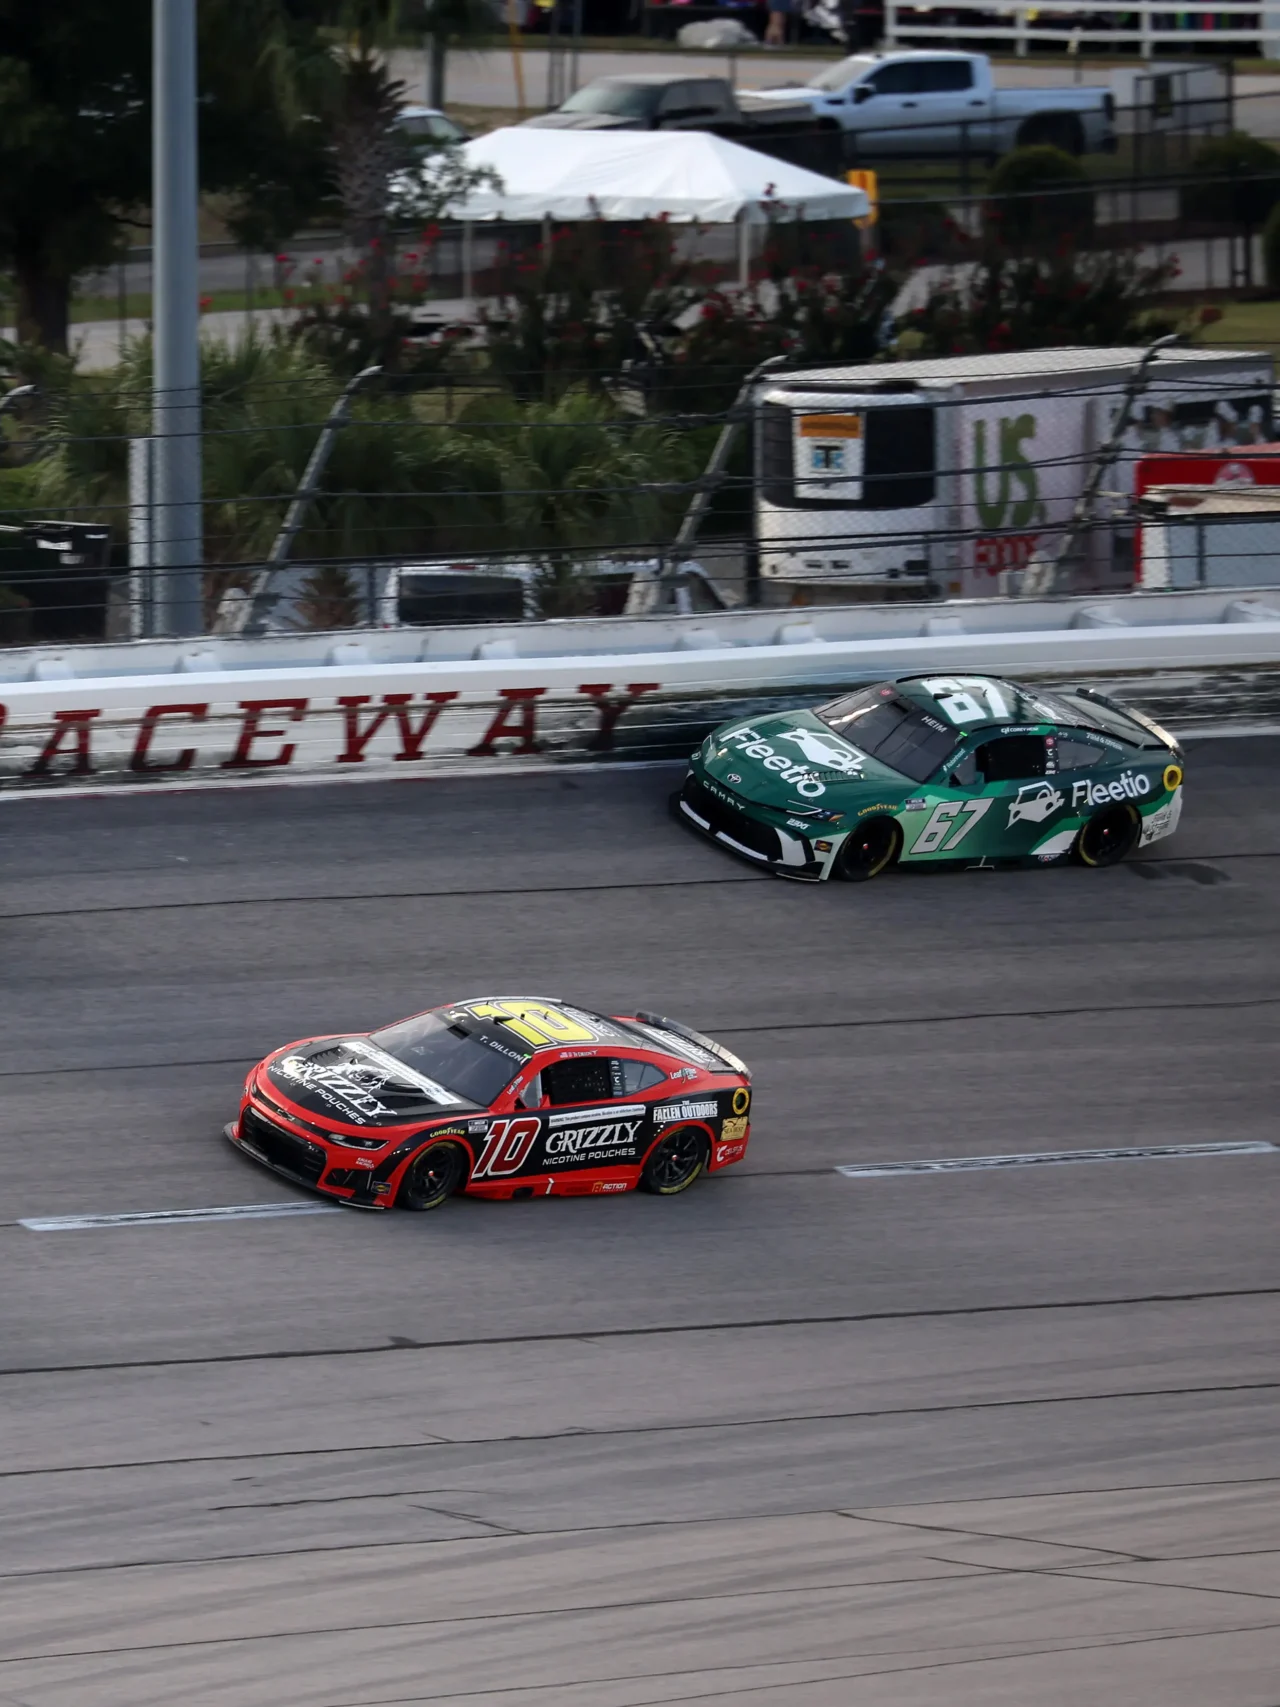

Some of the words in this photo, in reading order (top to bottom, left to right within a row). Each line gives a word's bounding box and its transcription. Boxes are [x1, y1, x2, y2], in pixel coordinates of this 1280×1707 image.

[921, 679, 1009, 724] 67
[920, 715, 948, 733] HEIM
[720, 727, 826, 798] Fleetio
[702, 780, 746, 811] CAMRY
[1072, 770, 1150, 807] Fleetio
[857, 803, 898, 817] GOODYEAR
[909, 797, 995, 855] 67
[468, 1000, 595, 1047] 10
[479, 1035, 488, 1044] T.
[489, 1041, 524, 1063] DILLON
[267, 1065, 317, 1091] NICOTINE
[315, 1088, 366, 1126] POUCHES
[280, 1055, 398, 1118] GRIZZLY
[653, 1107, 681, 1121] FALLEN
[681, 1103, 718, 1118] OUTDOORS
[429, 1126, 466, 1138] GOODYEAR
[470, 1117, 542, 1179] 10
[545, 1121, 643, 1154] GRIZZLY
[542, 1153, 586, 1166] NICOTINE
[588, 1148, 636, 1160] POUCHES
[602, 1182, 628, 1190] ACTION
